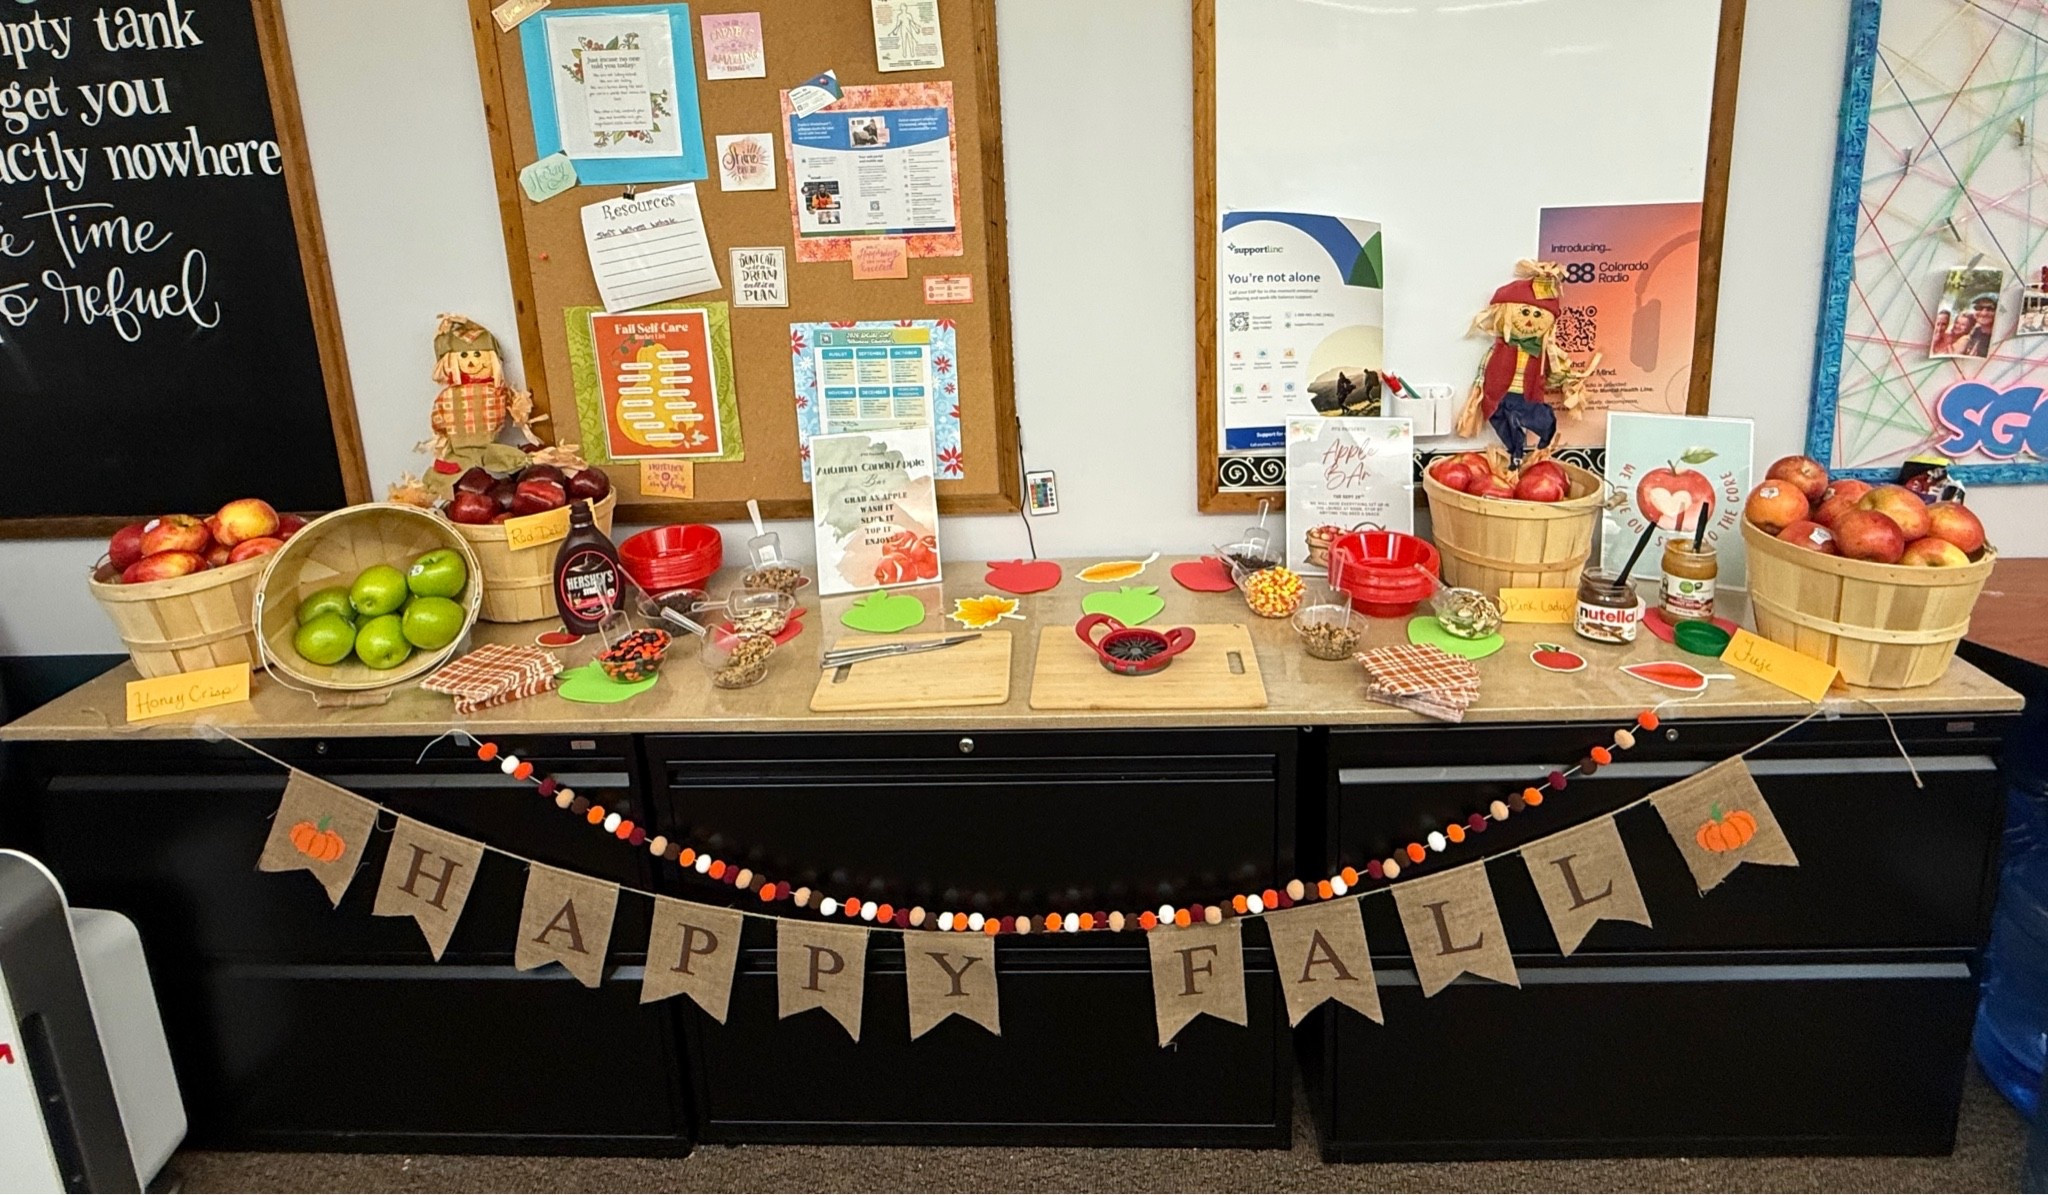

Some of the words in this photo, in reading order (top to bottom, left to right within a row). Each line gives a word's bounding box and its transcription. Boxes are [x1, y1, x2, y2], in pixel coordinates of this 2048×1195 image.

[93, 0, 204, 52] tank
[0, 76, 69, 134] get
[78, 77, 172, 127] you
[103, 126, 283, 181] nowhere
[722, 143, 759, 171] Shine
[602, 195, 676, 220] Resources
[22, 186, 173, 269] time
[1233, 245, 1284, 256] supportlinc
[742, 269, 778, 281] DREAM
[1228, 273, 1264, 285] You're
[1266, 273, 1286, 284] not
[1288, 271, 1321, 283] alone
[1561, 262, 1596, 284] 88
[1598, 260, 1649, 272] Colorado
[1598, 272, 1630, 283] Radio
[41, 249, 222, 342] refuel
[743, 289, 778, 302] PLAN
[615, 323, 636, 335] Fall
[637, 323, 659, 334] Self
[660, 321, 689, 333] Care
[1570, 361, 1586, 369] hat
[1596, 368, 1617, 377] Mind.
[1322, 438, 1379, 468] Apple
[816, 464, 858, 476] Autumn
[862, 460, 895, 473] Candy
[896, 458, 925, 470] Apple
[1619, 463, 1637, 481] WE
[864, 474, 887, 487] Bar
[1720, 470, 1740, 503] CORE
[845, 496, 867, 505] GRAB
[869, 494, 882, 502] AN
[882, 491, 907, 502] APPLE
[860, 504, 884, 513] WASH
[885, 503, 894, 512] IT
[886, 514, 895, 523] IT
[1716, 509, 1738, 531] THE
[511, 527, 535, 546] Red
[865, 526, 881, 535] TOP
[883, 525, 892, 533] IT
[566, 570, 615, 591] HERSHEY'S
[1505, 596, 1536, 611] Pink
[1540, 600, 1573, 621] Lady
[1580, 606, 1635, 623] nutella
[134, 690, 186, 714] Honey
[188, 684, 240, 703] Crisp
[397, 843, 984, 997] HAPPY
[1174, 853, 1614, 997] FALL
